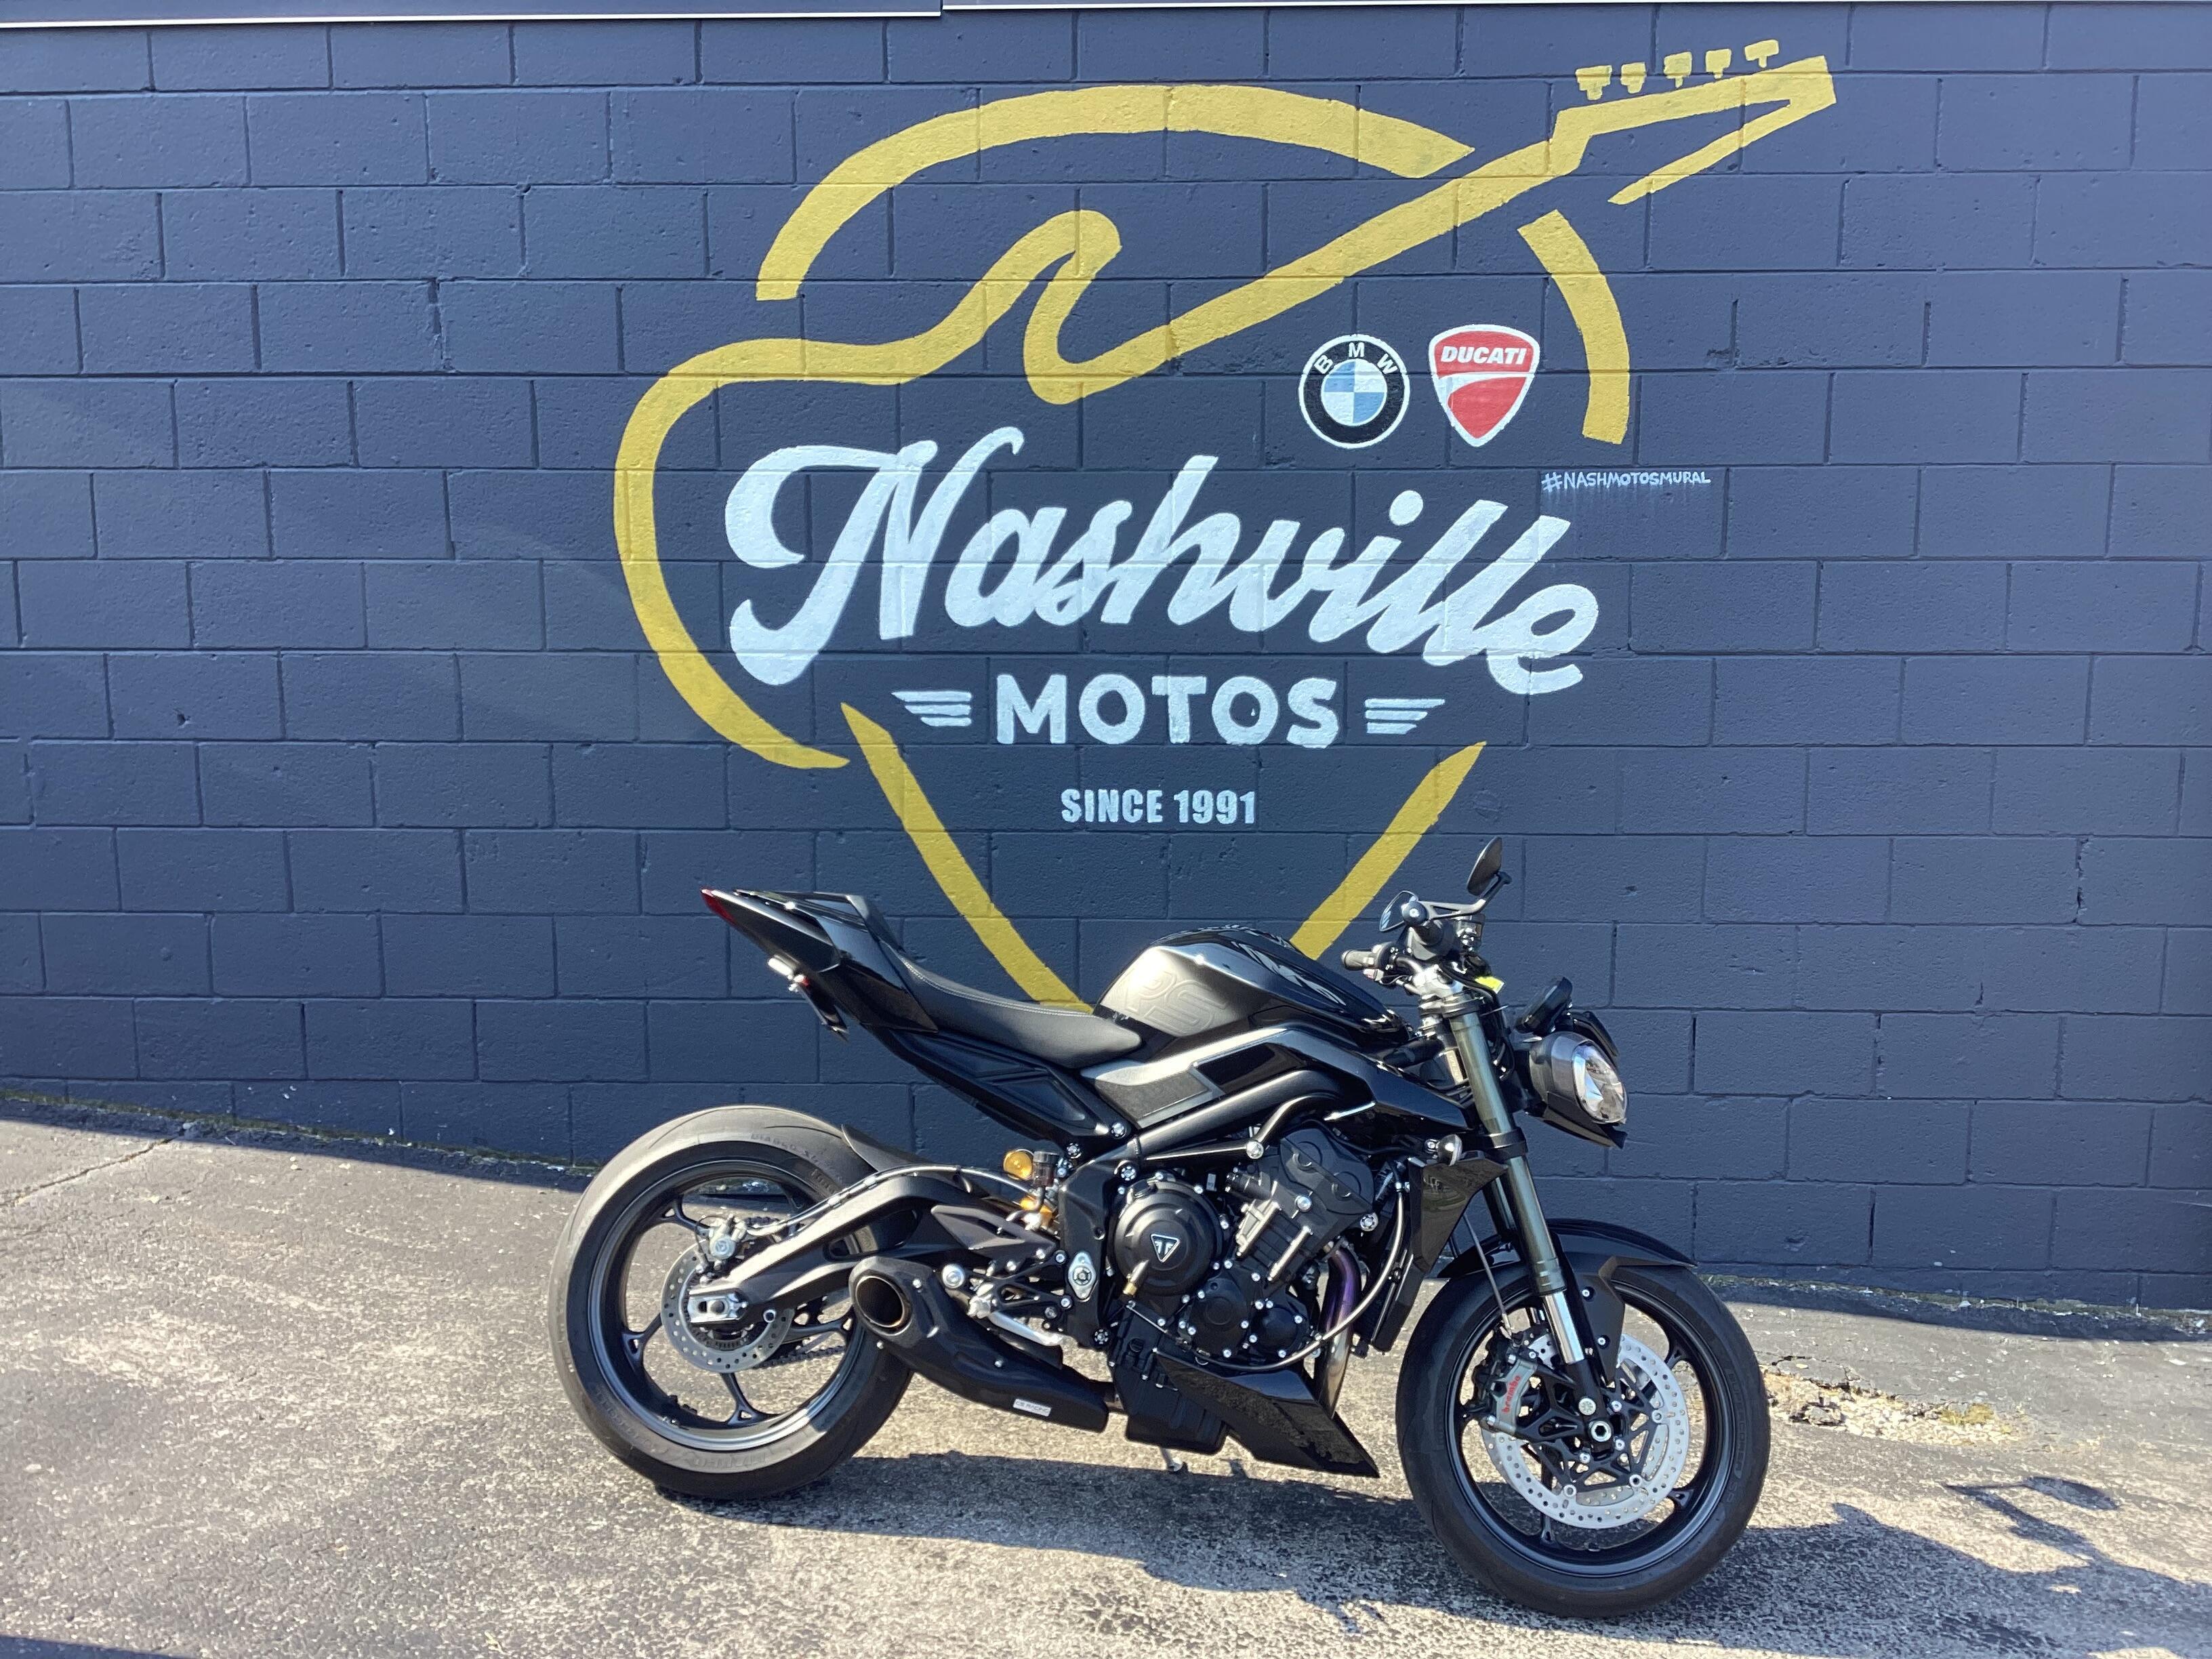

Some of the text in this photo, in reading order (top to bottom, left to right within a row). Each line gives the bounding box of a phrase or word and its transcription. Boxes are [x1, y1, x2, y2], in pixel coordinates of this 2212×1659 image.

[1315, 342, 1397, 375] BMW
[1441, 346, 1529, 366] DUCATI
[1541, 471, 1712, 493] #NASHMOTOSMURAL
[724, 426, 1600, 696] Nashville
[996, 674, 1339, 749] MOTOS
[1061, 789, 1256, 825] SINCE 1991
[1501, 1374, 1521, 1414] brembo
